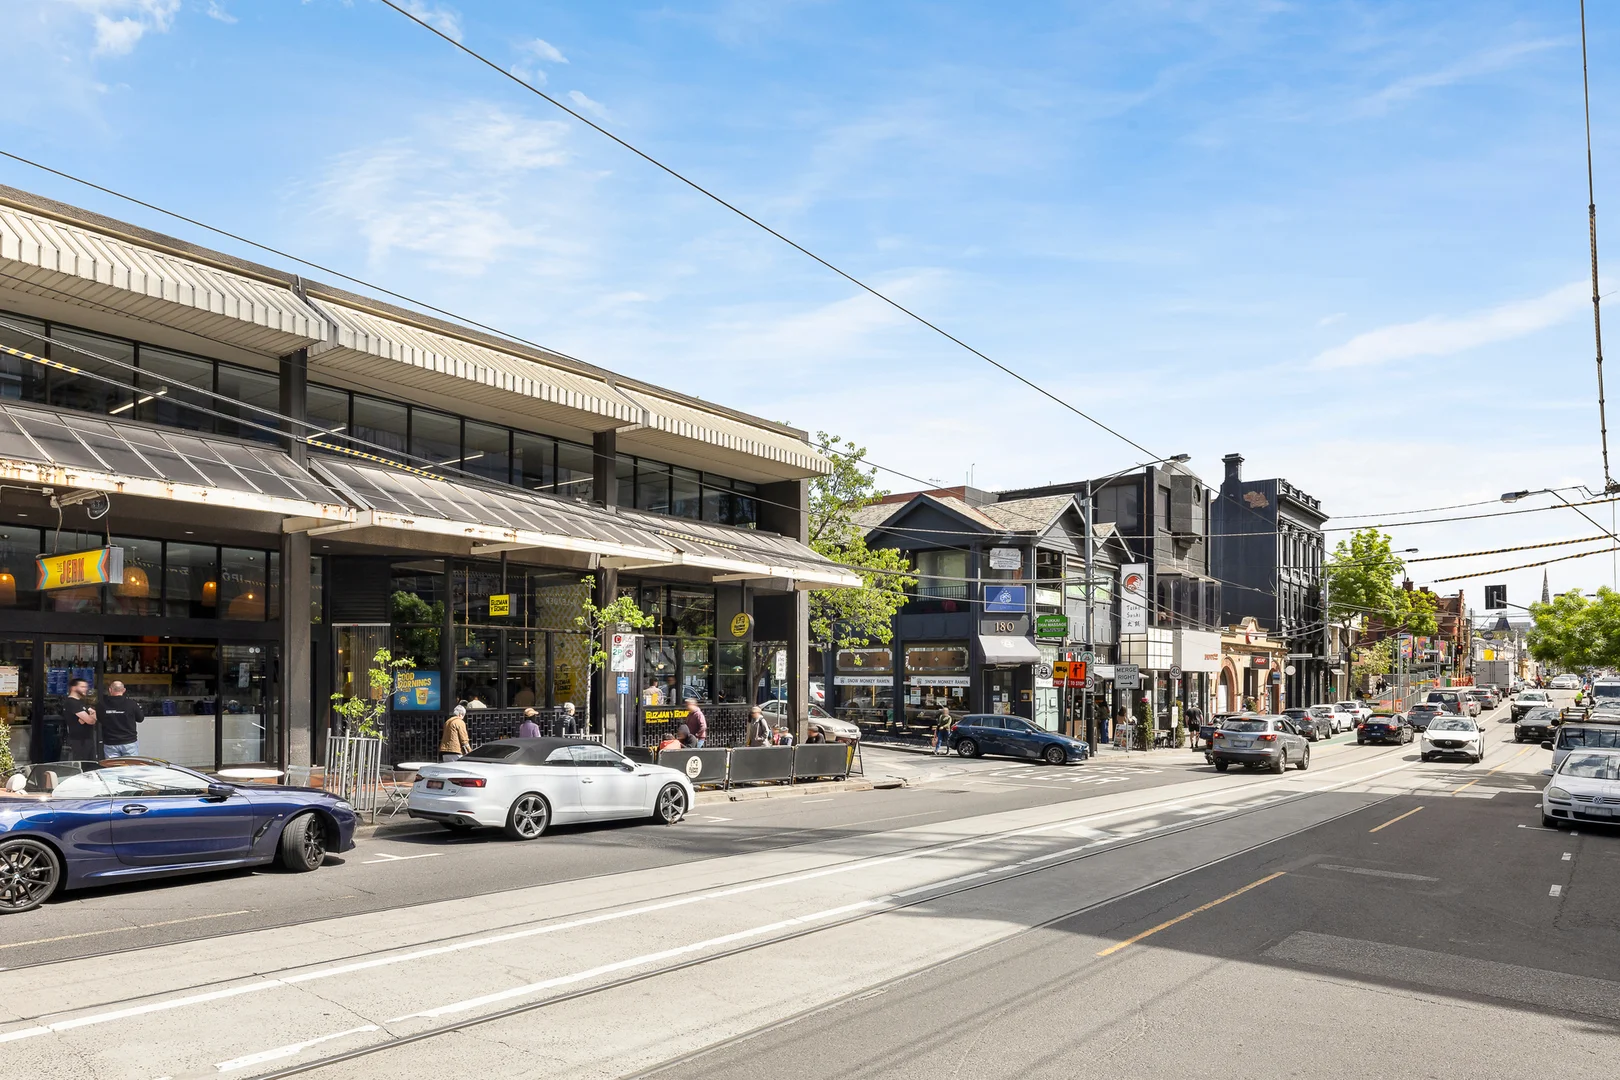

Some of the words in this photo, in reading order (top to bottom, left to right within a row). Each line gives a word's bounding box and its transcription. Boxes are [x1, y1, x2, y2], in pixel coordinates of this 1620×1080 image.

[60, 558, 85, 584] JERK
[995, 621, 1015, 632] 180
[1171, 667, 1180, 675] 40
[646, 711, 670, 719] GUZMAN
